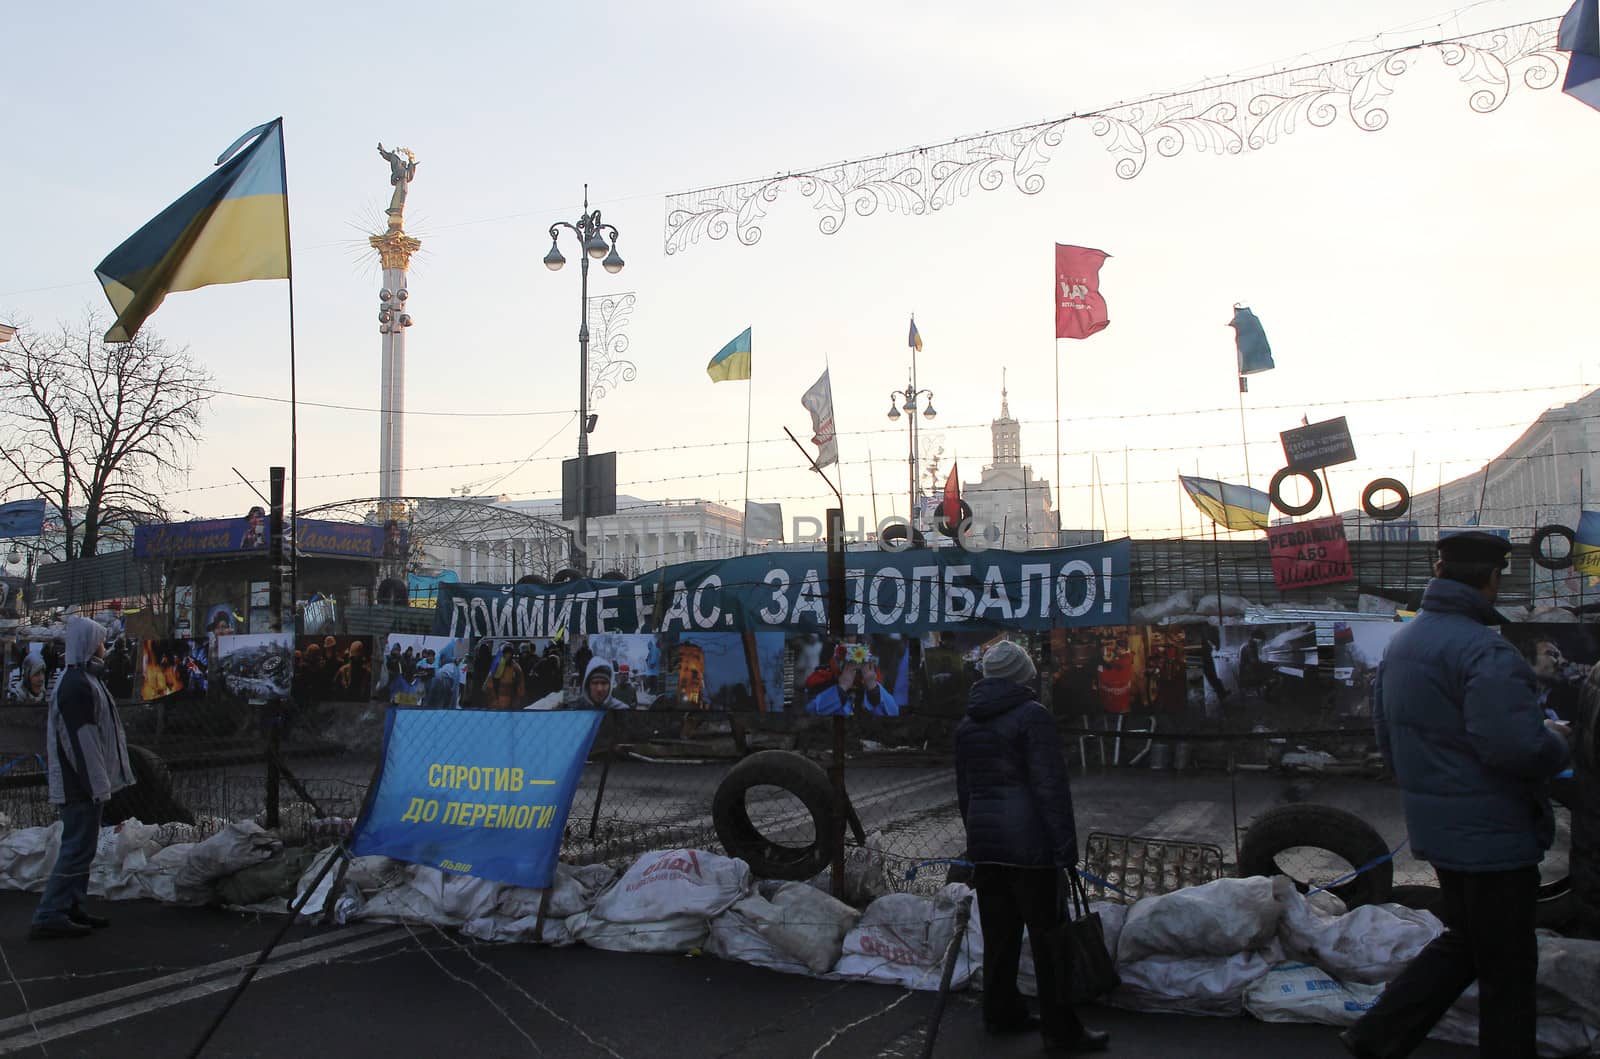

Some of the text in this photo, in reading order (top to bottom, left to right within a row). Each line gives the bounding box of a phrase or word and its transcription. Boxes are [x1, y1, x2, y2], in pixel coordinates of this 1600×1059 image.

[449, 557, 1113, 639] ПОЙМИТЕ НАС. ЗАДОЛБАЛО!
[428, 763, 524, 792] СПРОТИВ
[401, 797, 556, 830] ДО ПЕРЕМОГИ!
